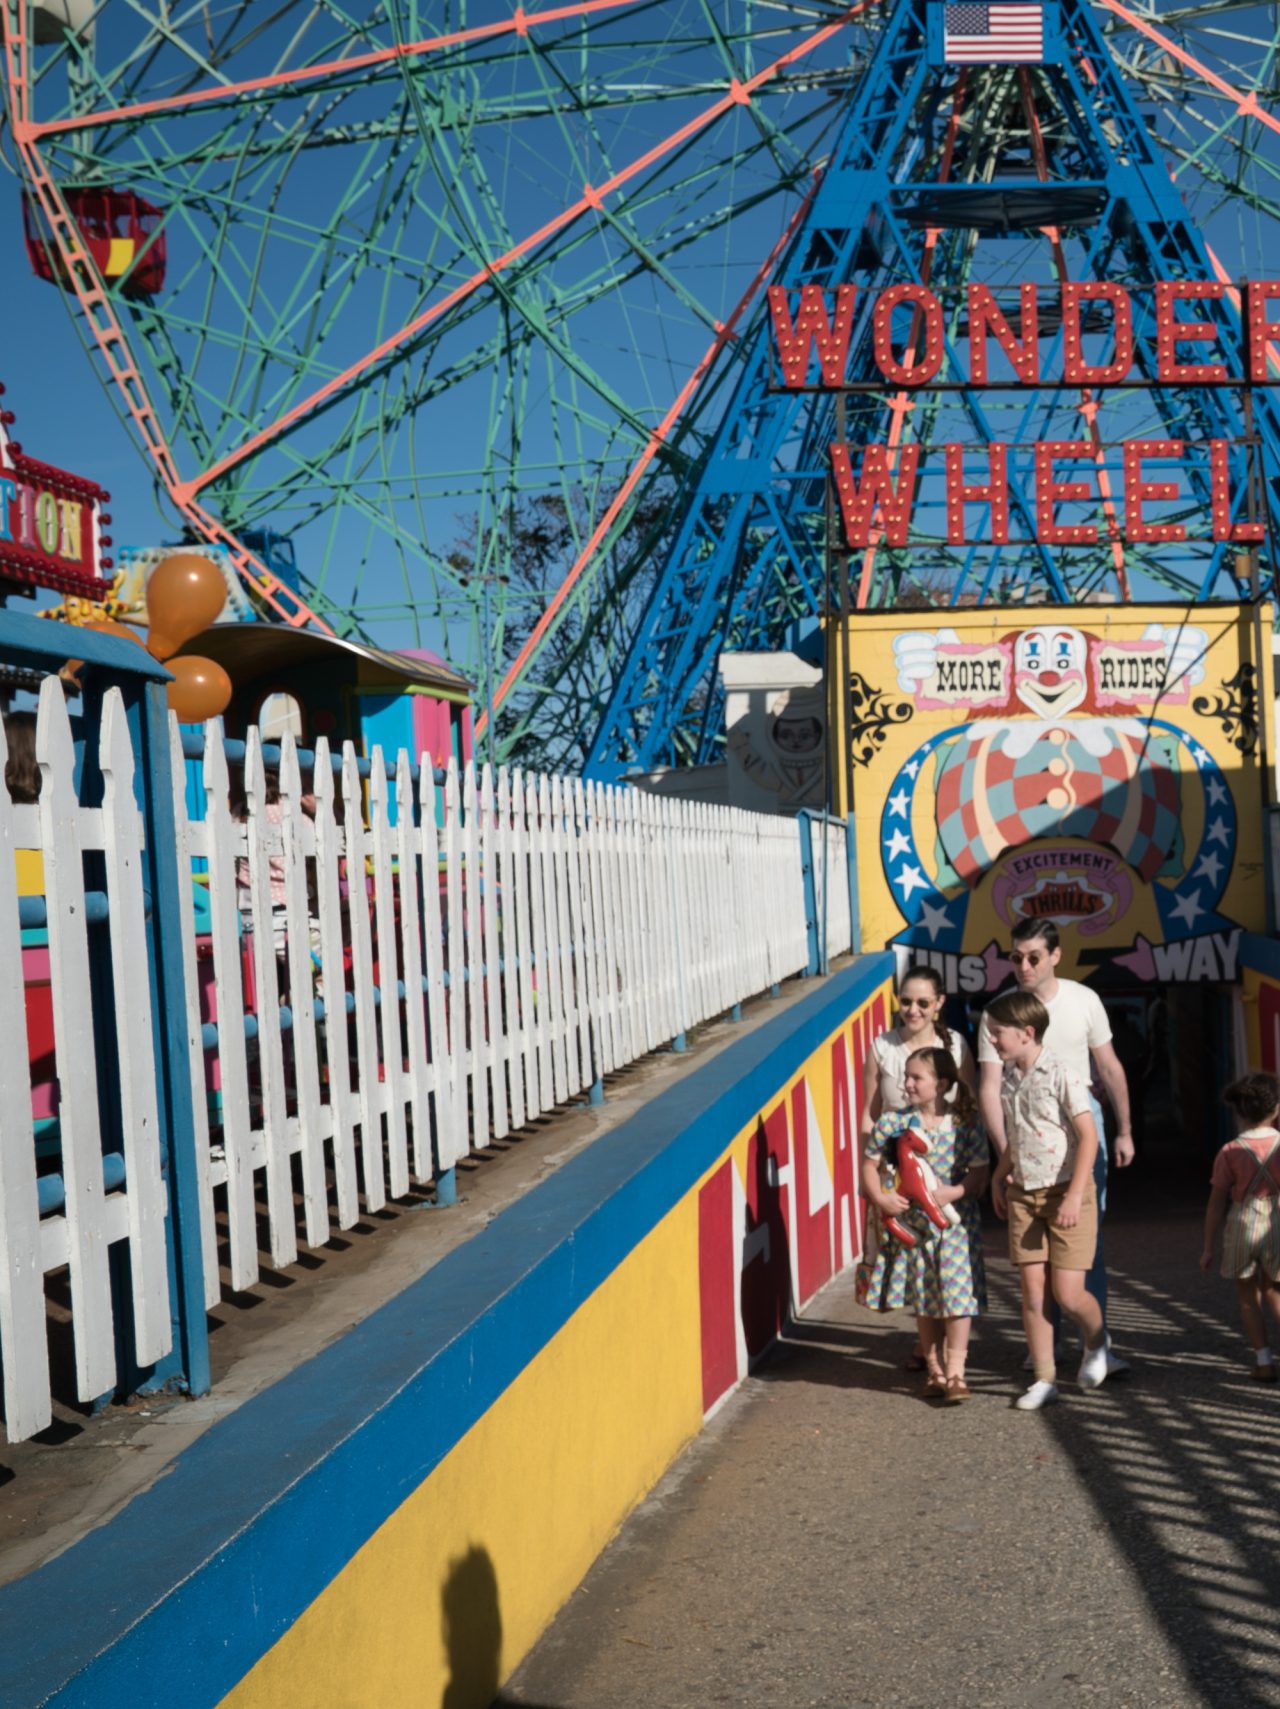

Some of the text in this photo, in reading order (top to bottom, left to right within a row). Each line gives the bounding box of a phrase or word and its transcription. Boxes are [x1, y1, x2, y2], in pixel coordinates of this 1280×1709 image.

[829, 439, 1265, 548] WHEEL
[936, 656, 1167, 692] MORE RIDES
[1013, 852, 1114, 876] EXCITEMENT
[1028, 891, 1098, 916] THRILLS
[1154, 930, 1244, 982] WAY
